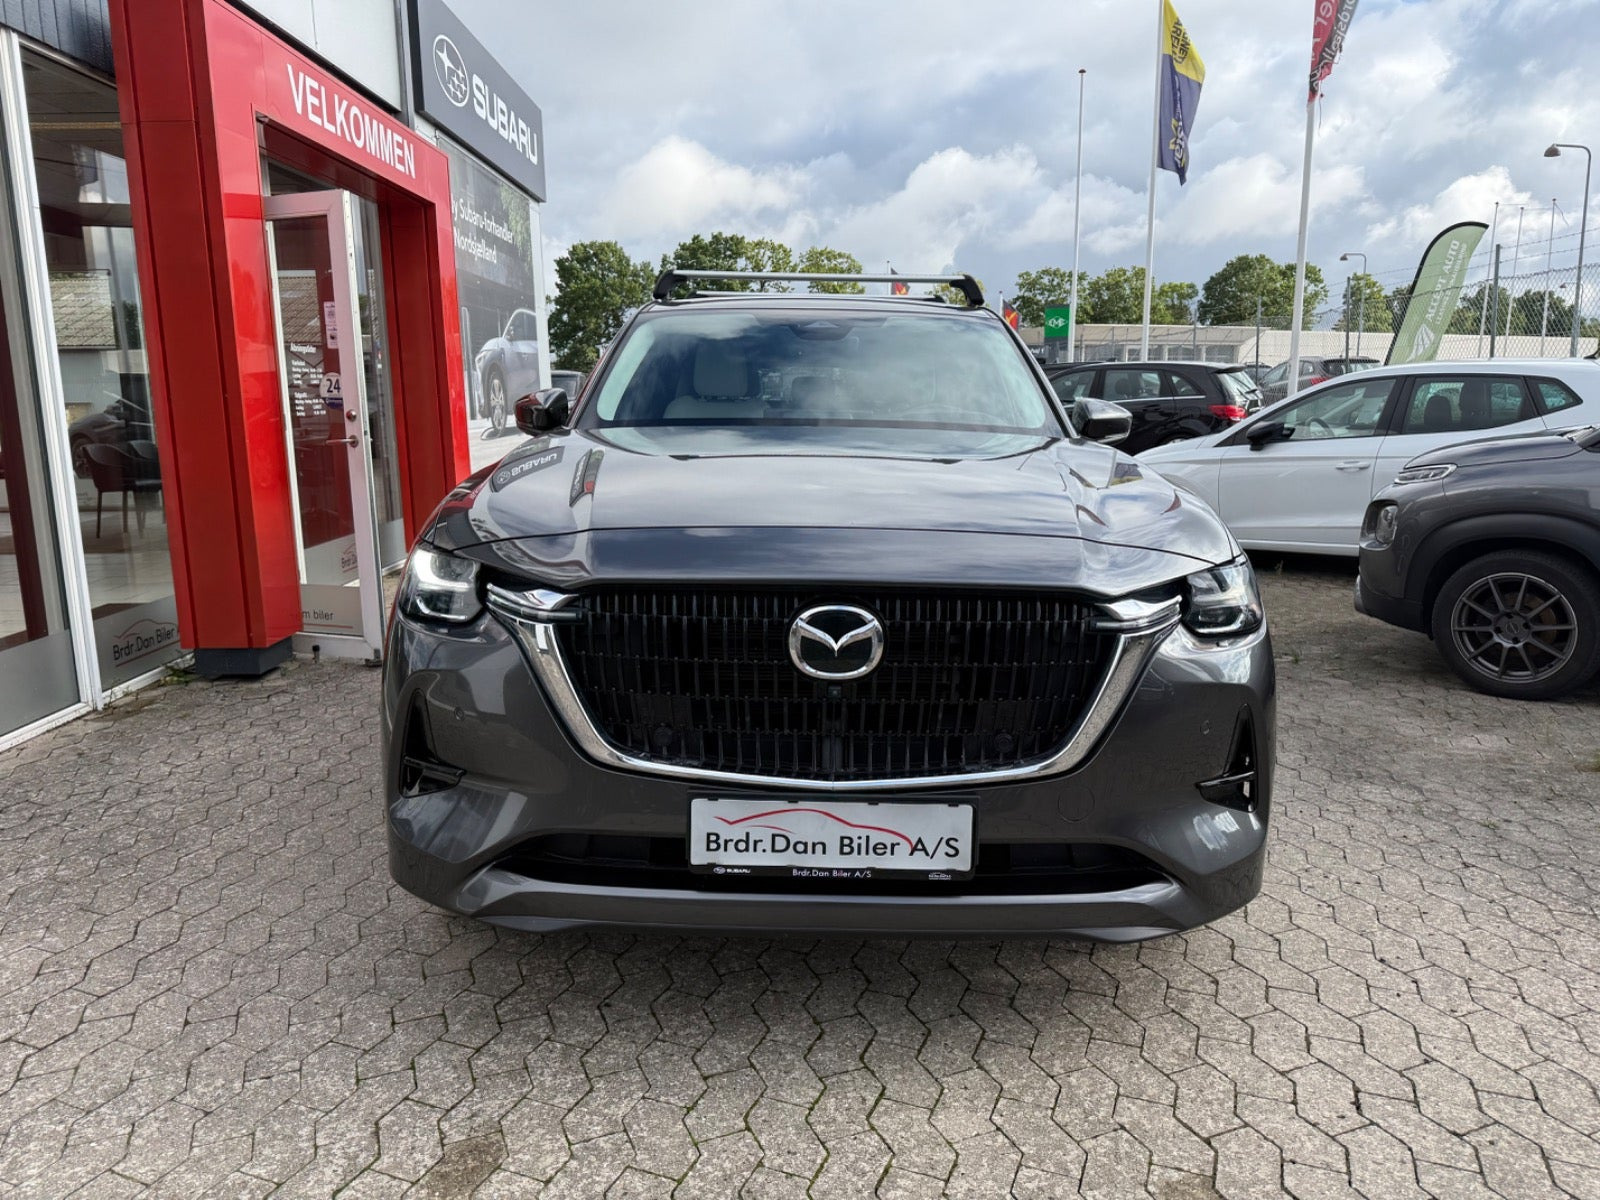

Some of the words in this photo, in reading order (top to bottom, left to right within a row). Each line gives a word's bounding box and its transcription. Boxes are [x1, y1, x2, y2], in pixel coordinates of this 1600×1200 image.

[286, 63, 416, 179] VELKOMMEN
[472, 73, 538, 165] SUBARU
[459, 198, 513, 244] Subaru-forhandler
[453, 226, 497, 264] Nordsjælland
[326, 378, 342, 393] 24
[706, 832, 827, 855] Brdr.Dan
[839, 835, 901, 856] Biler
[909, 836, 960, 859] A/S
[792, 868, 829, 877] Brdr.Dan
